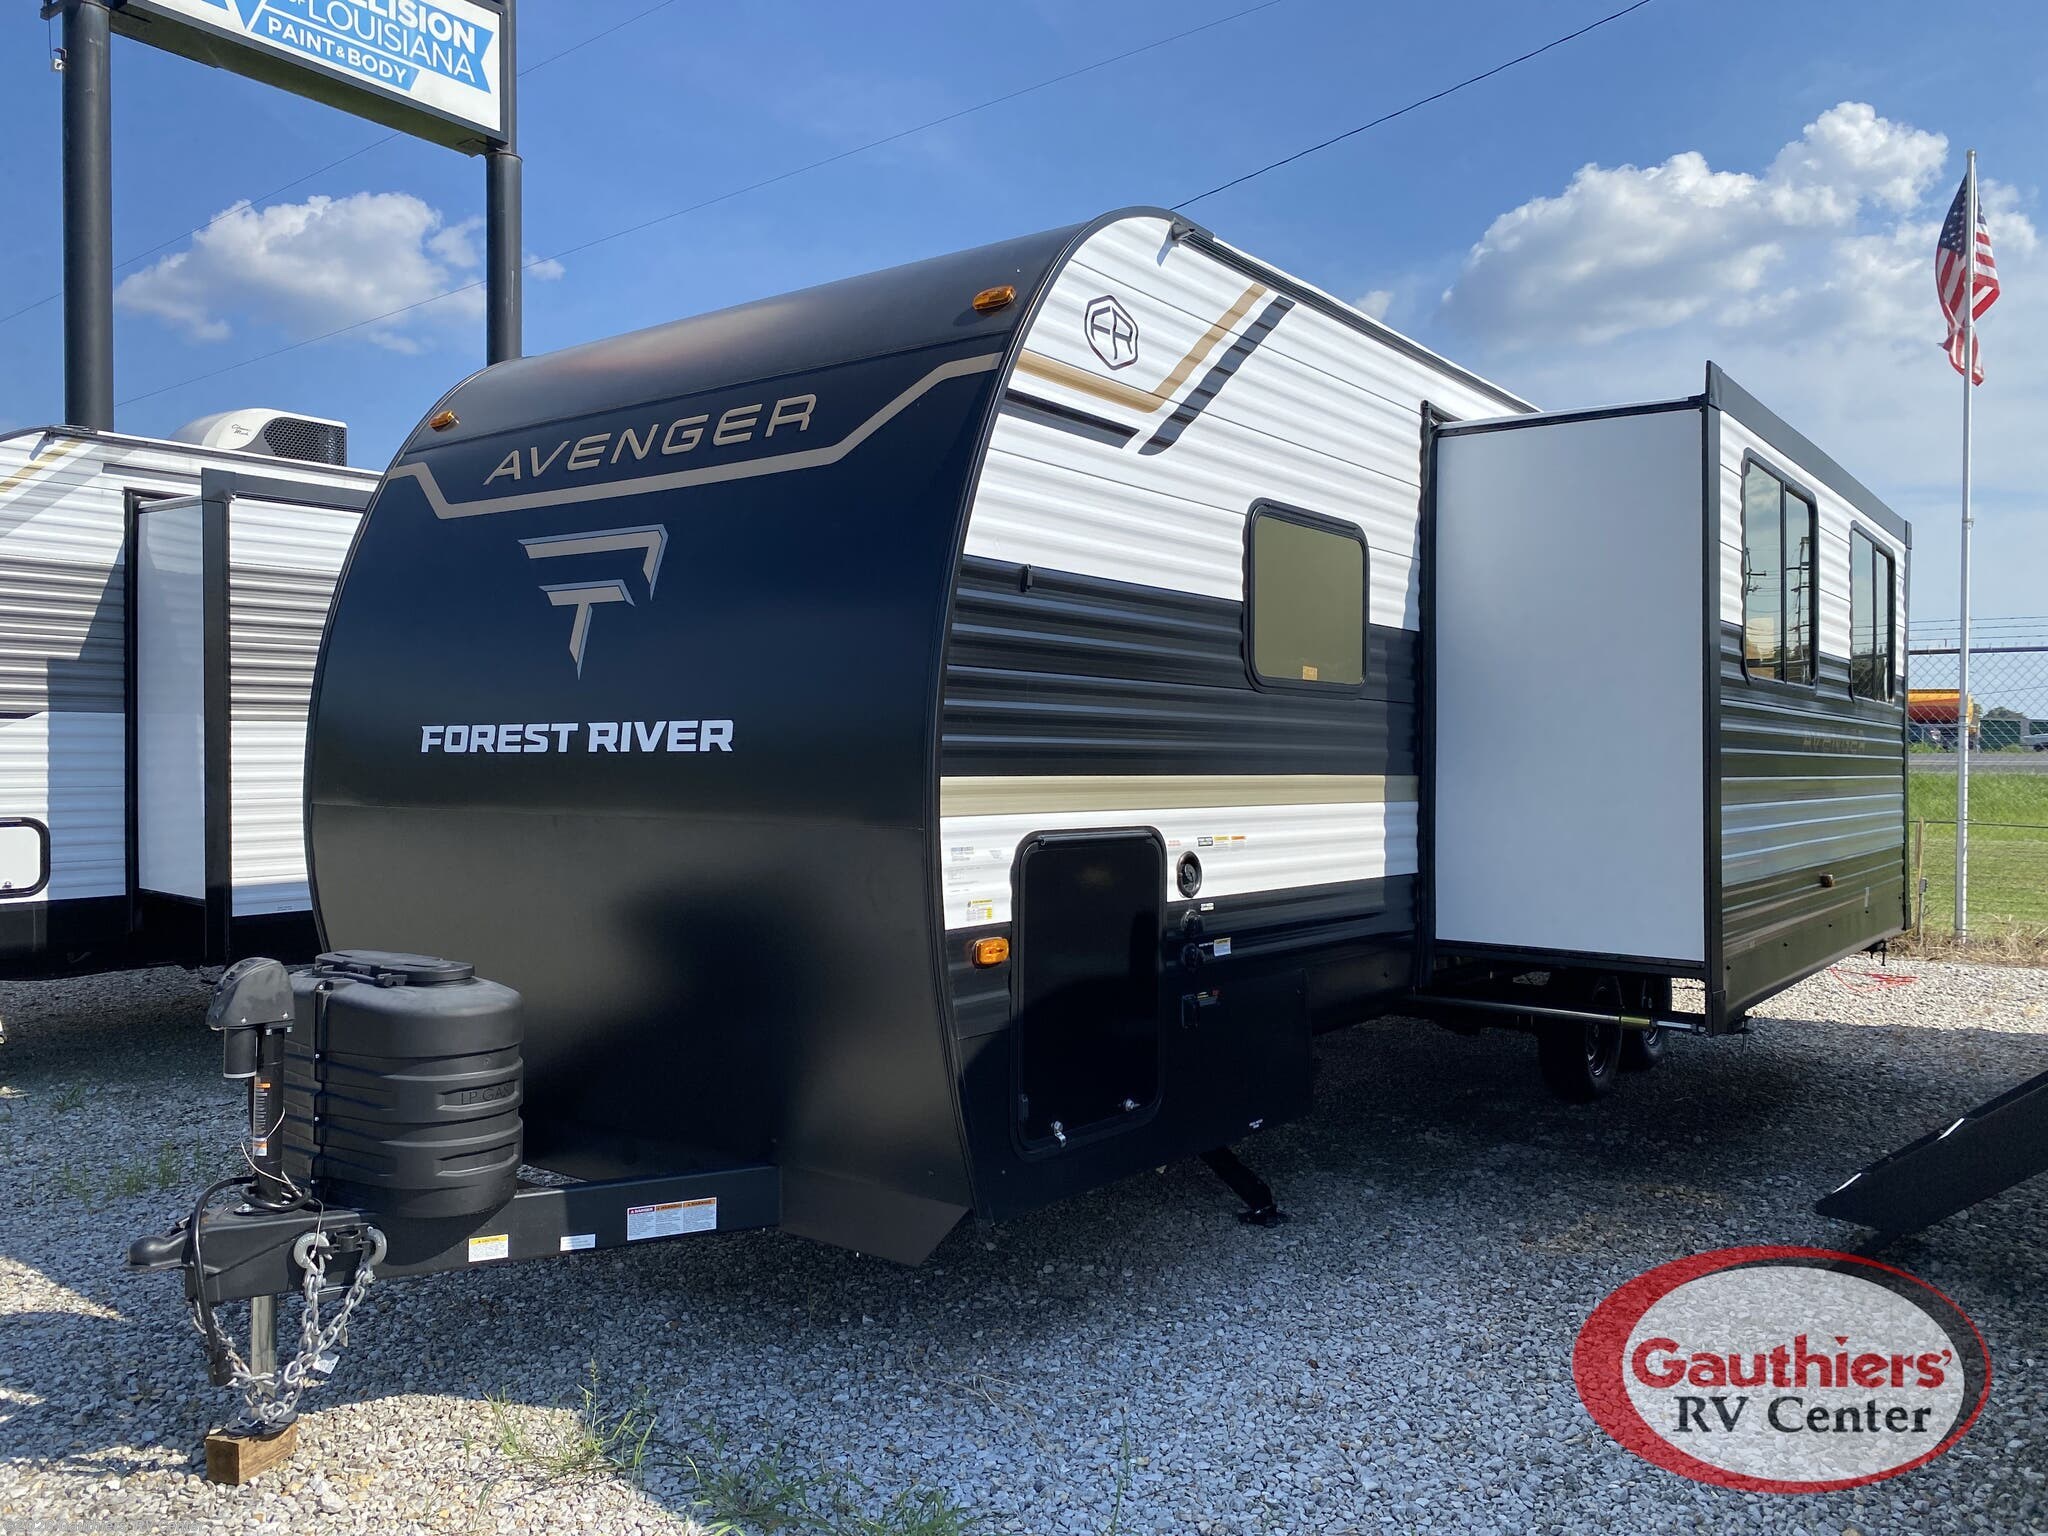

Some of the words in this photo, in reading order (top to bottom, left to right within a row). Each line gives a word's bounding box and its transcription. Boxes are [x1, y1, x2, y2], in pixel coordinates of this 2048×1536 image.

[308, 0, 476, 83] LOUISIANA
[482, 393, 817, 486] AVENGER
[421, 722, 579, 753] FOREST
[588, 719, 734, 753] RIVER
